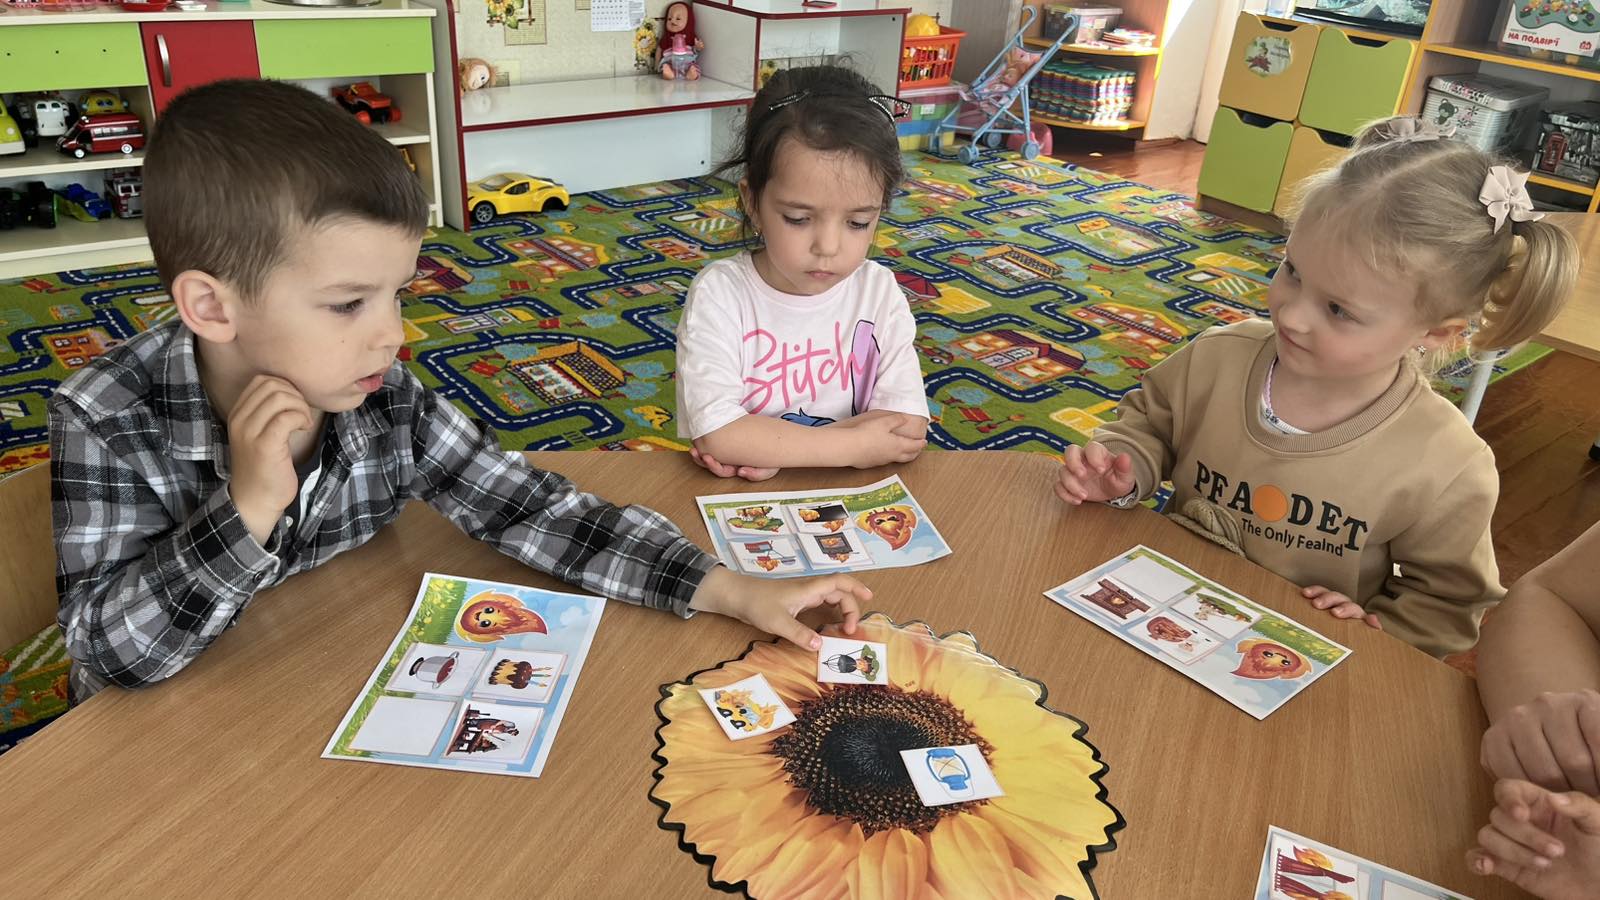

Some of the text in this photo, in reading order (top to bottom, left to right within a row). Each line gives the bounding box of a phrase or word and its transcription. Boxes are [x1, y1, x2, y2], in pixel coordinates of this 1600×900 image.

[1508, 32, 1519, 40] НА
[740, 321, 864, 414] Stitch
[1241, 518, 1262, 536] The
[1264, 526, 1295, 548] Only
